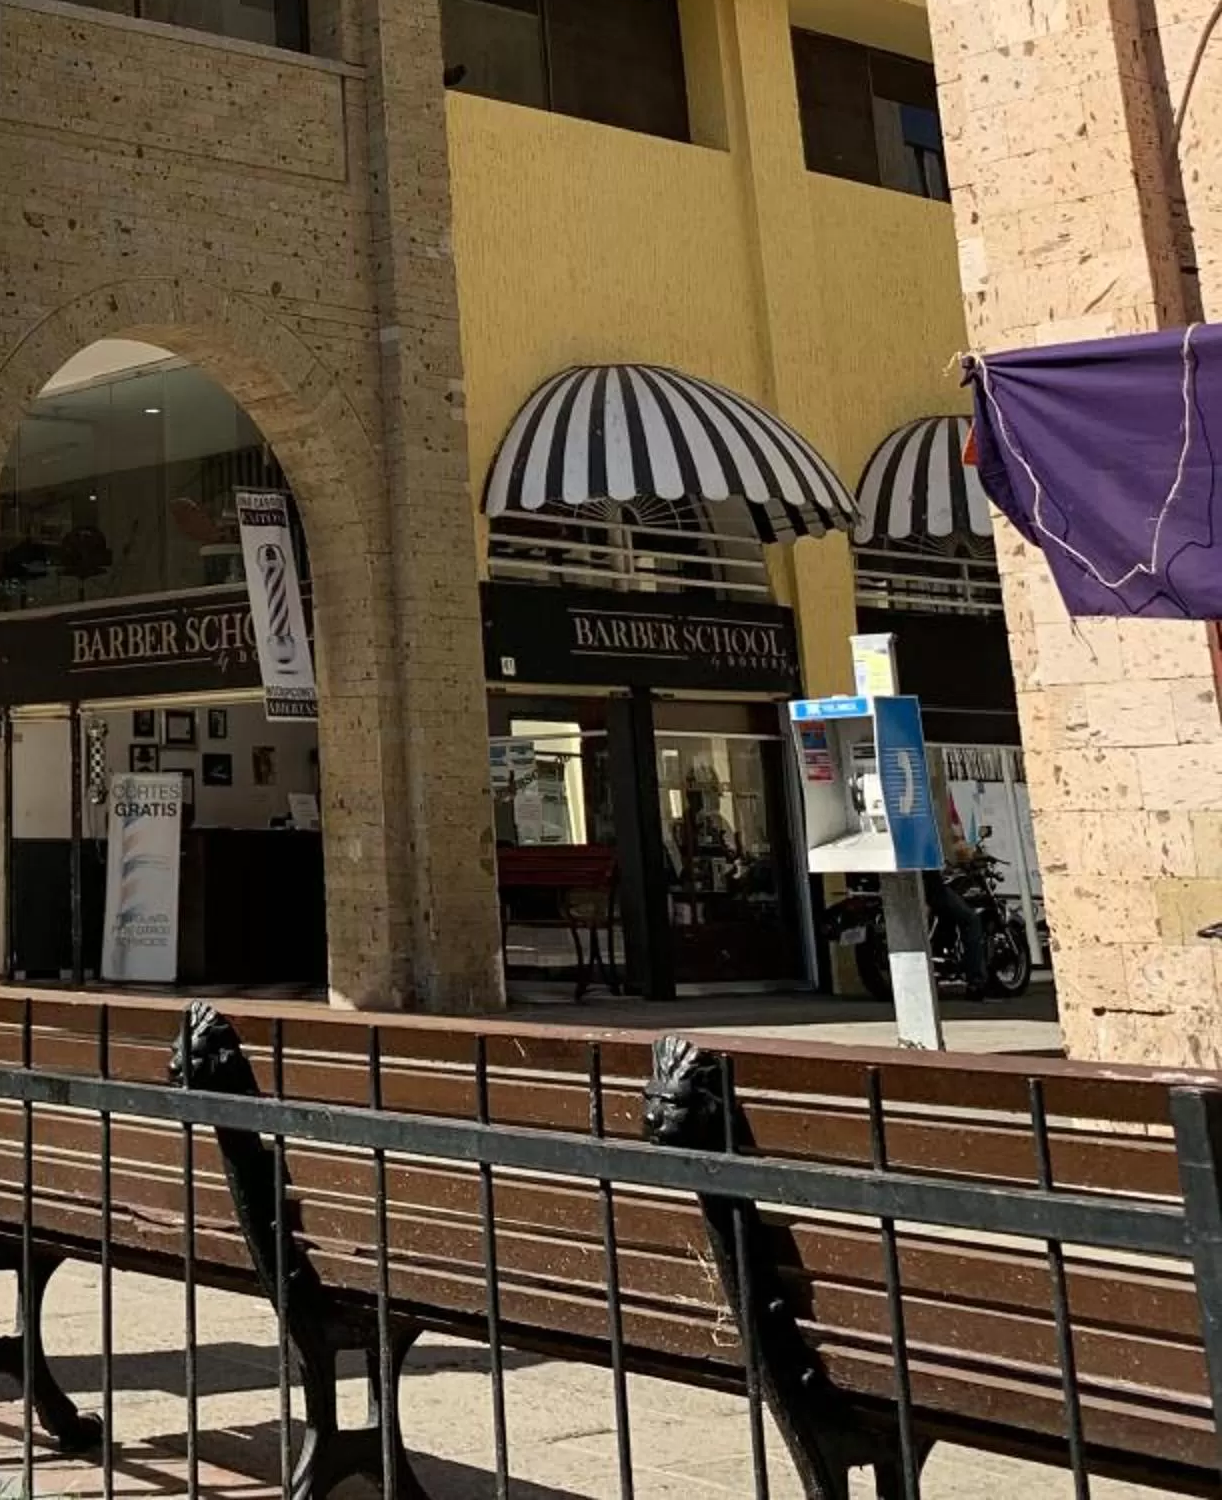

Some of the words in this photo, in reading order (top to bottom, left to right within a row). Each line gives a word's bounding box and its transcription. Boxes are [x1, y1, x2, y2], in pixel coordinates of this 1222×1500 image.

[72, 620, 179, 663] BARBER
[185, 612, 258, 653] SCHO
[573, 616, 678, 650] BARBER
[682, 623, 787, 657] SCHOOL
[114, 802, 177, 817] GRATIS
